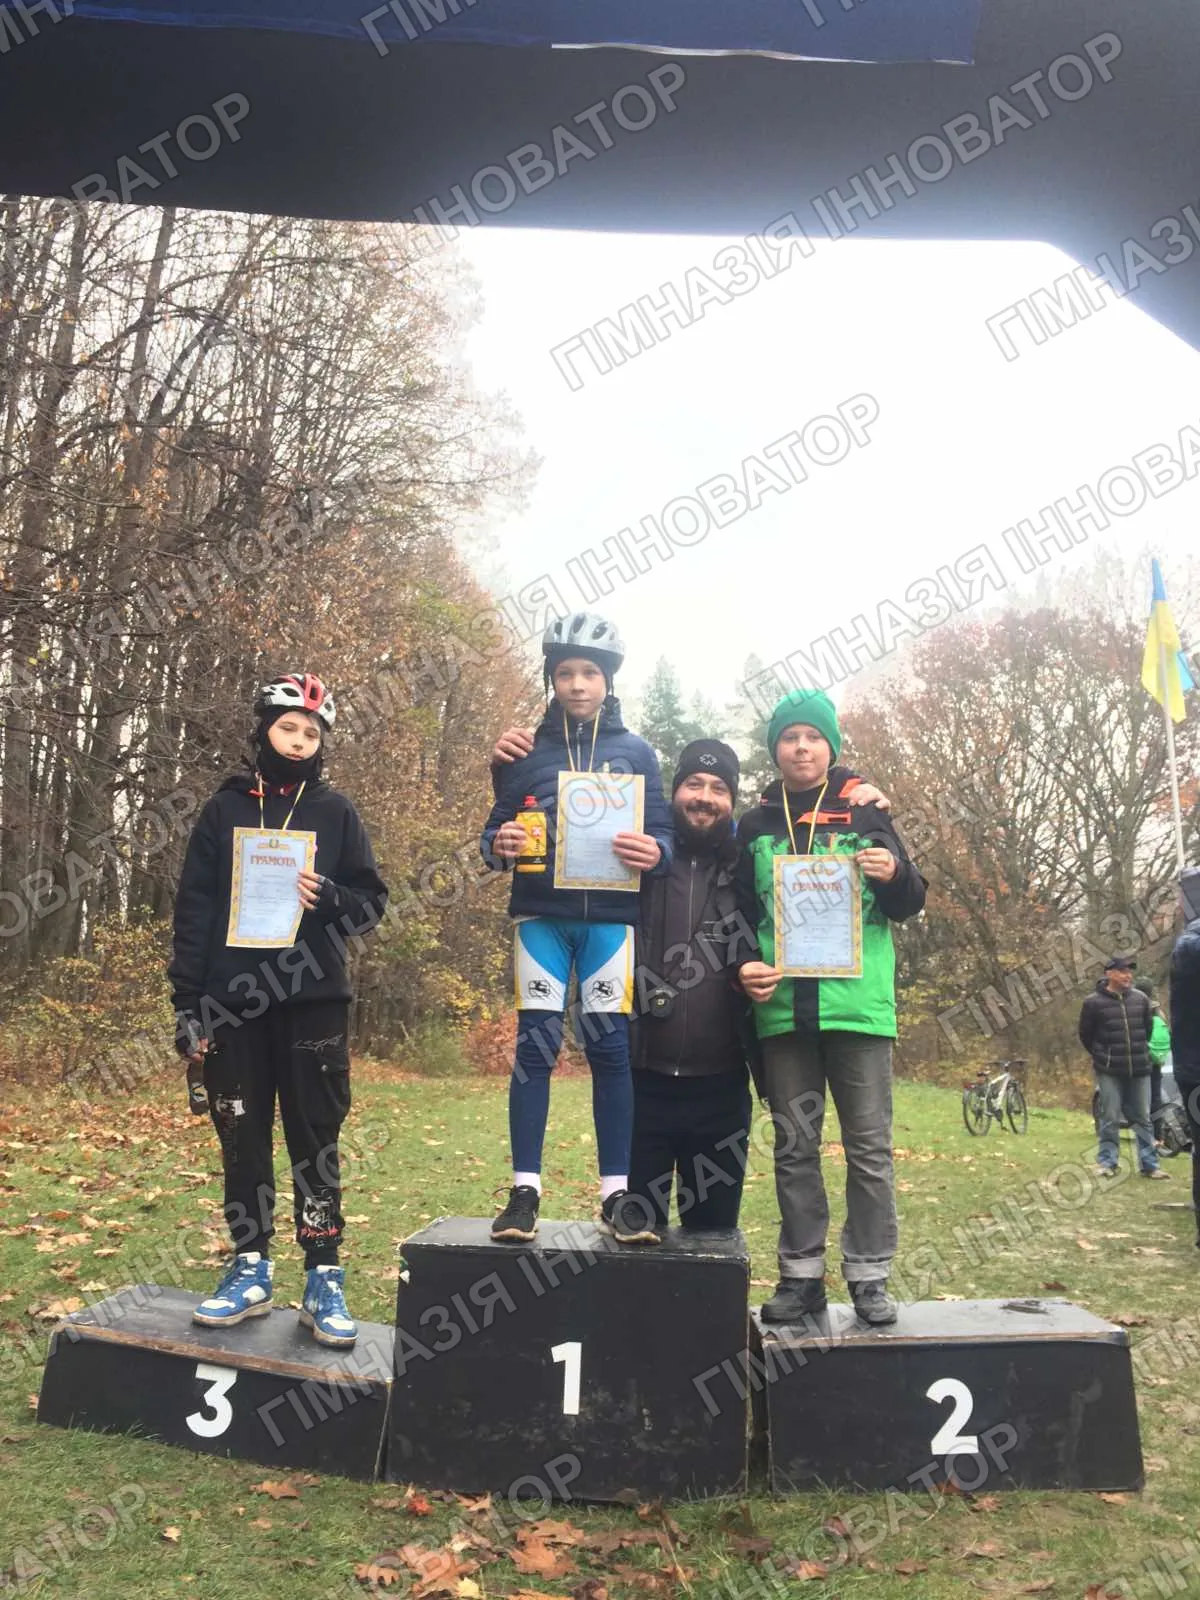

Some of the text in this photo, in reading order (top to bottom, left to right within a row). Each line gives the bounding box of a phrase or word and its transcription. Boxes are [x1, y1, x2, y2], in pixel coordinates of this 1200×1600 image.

[250, 854, 297, 867] ГРАМОТА
[185, 1363, 238, 1438] 3
[551, 1342, 582, 1415] 1
[926, 1377, 979, 1455] 2
